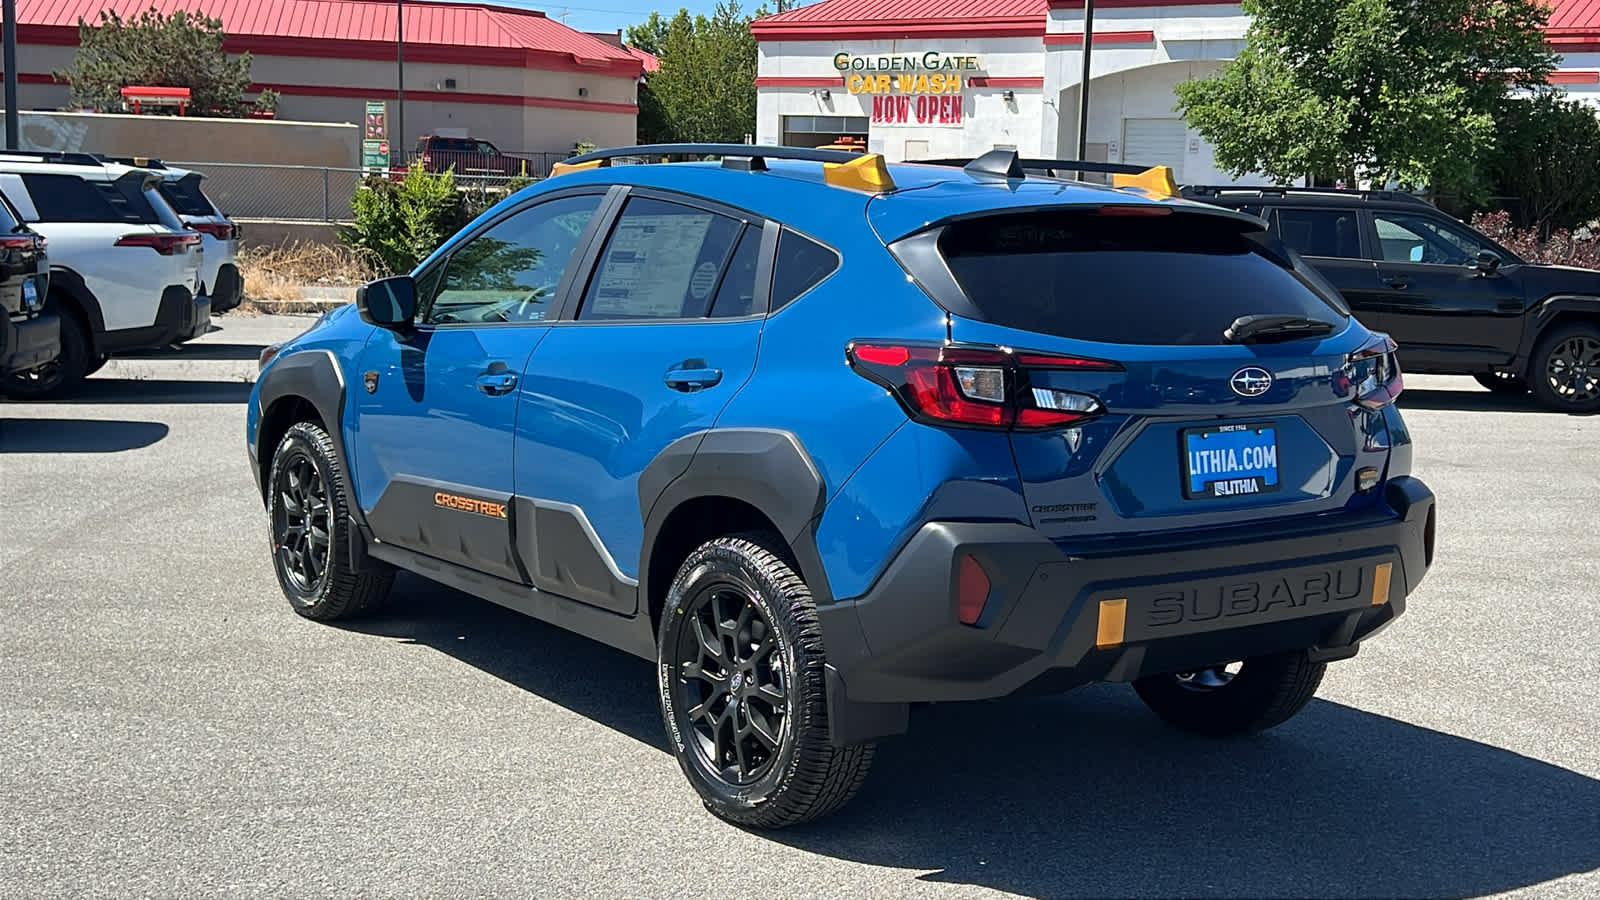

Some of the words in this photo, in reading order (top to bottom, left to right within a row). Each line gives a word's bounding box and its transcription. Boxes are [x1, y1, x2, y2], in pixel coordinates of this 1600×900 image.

[833, 52, 917, 71] GOLDEN
[922, 51, 977, 70] GATE
[848, 74, 891, 94] CAR
[898, 73, 961, 94] WASH
[872, 95, 911, 123] NOW
[916, 95, 963, 123] OPEN
[1188, 445, 1277, 475] LITHIA.COM
[1224, 478, 1259, 494] LITHIA
[435, 492, 507, 518] CROSSTREK
[1147, 567, 1363, 627] SUBARU
